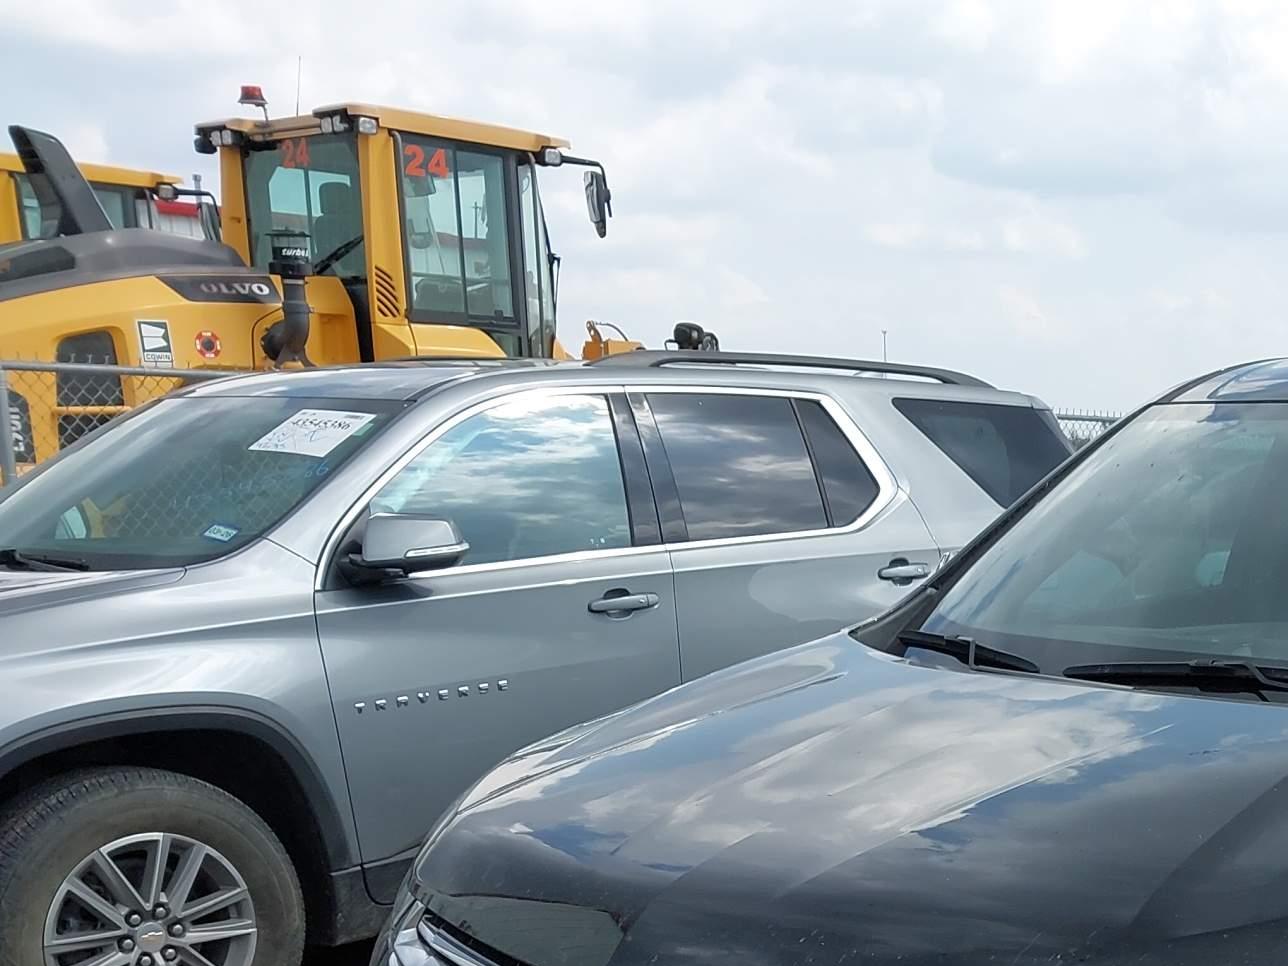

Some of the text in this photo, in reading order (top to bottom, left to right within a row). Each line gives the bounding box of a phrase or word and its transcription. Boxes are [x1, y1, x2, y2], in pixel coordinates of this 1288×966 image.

[281, 138, 311, 168] 24
[404, 144, 450, 178] 24
[354, 679, 508, 714] TRAVERSE
